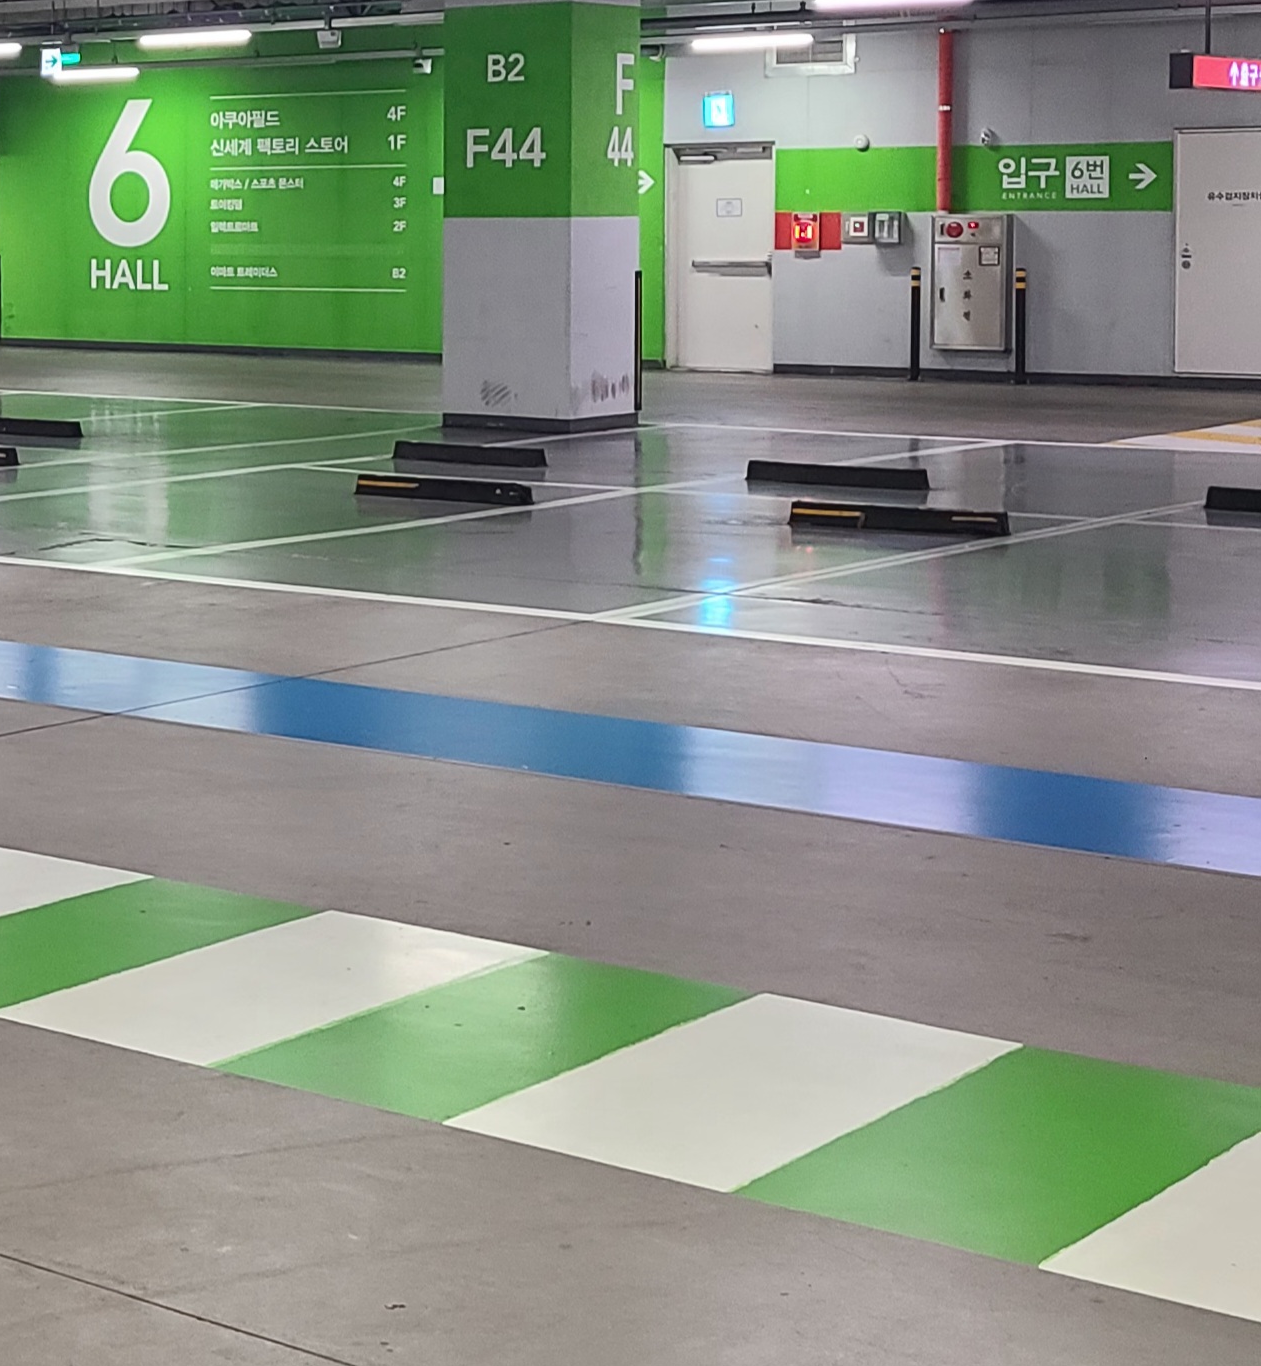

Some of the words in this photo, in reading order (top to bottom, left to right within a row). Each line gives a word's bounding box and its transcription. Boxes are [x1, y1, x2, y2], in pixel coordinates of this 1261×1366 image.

[487, 53, 525, 82] B2
[616, 53, 635, 115] F
[210, 110, 280, 129] 아쿠아필드
[387, 106, 406, 121] 4F
[210, 138, 252, 156] 신세계
[257, 137, 299, 155] 팩토리
[304, 136, 348, 153] 스토어
[387, 135, 406, 150] 1F
[467, 127, 546, 168] F44
[607, 126, 634, 167] 44
[89, 98, 171, 247] 6
[998, 157, 1060, 189] 입구
[1070, 160, 1104, 180] 6번
[392, 176, 406, 187] 4F
[1070, 184, 1104, 194] HALL
[393, 197, 406, 208] 3F
[1002, 192, 1057, 200] ENTRANCE
[393, 221, 406, 232] 2F
[90, 258, 169, 290] HALL
[392, 267, 406, 279] B2
